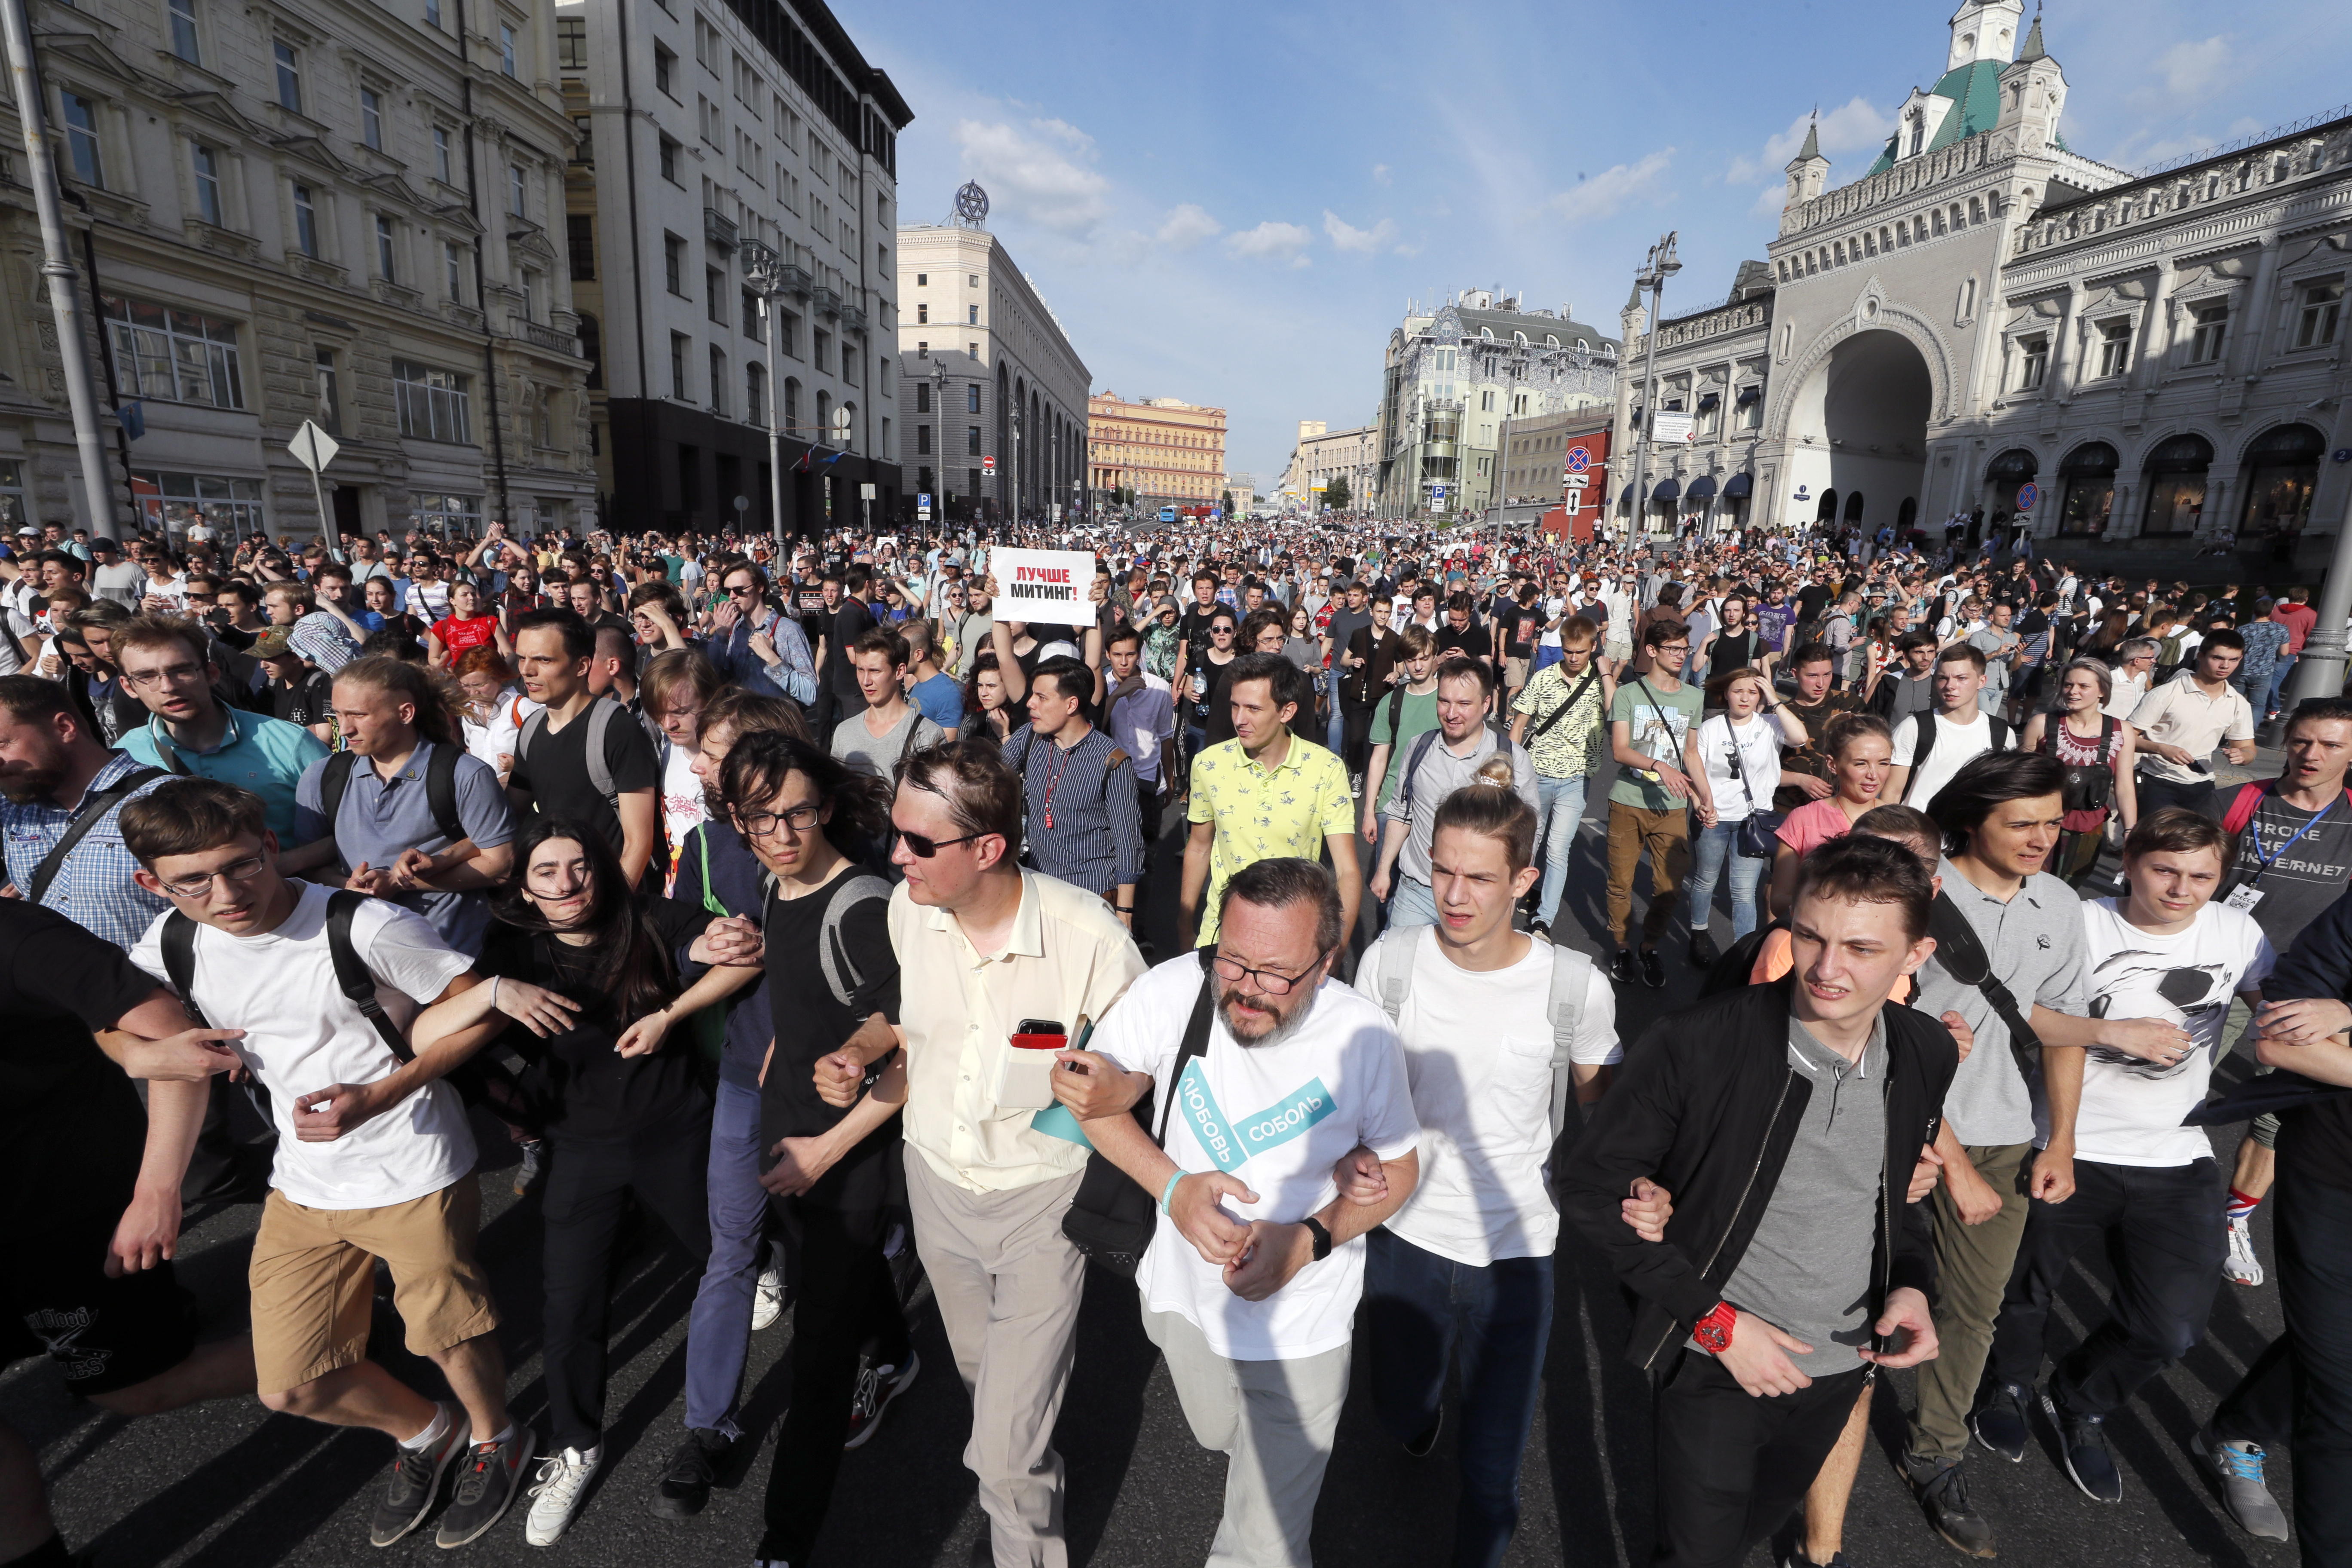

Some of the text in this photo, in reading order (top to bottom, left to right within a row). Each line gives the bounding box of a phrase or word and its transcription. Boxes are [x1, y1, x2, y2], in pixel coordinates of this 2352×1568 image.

[2339, 451, 2346, 459] 2
[1435, 487, 1443, 497] P
[921, 495, 928, 505] P
[1017, 567, 1070, 583] ЛУЧШЕ
[1011, 583, 1077, 601] МИТИНГ!
[293, 712, 300, 721] H
[2230, 892, 2256, 904] ПРЕССА
[1185, 1078, 1231, 1163] ЛЮБОВЬ
[1249, 1096, 1323, 1142] СОБОЛЬ
